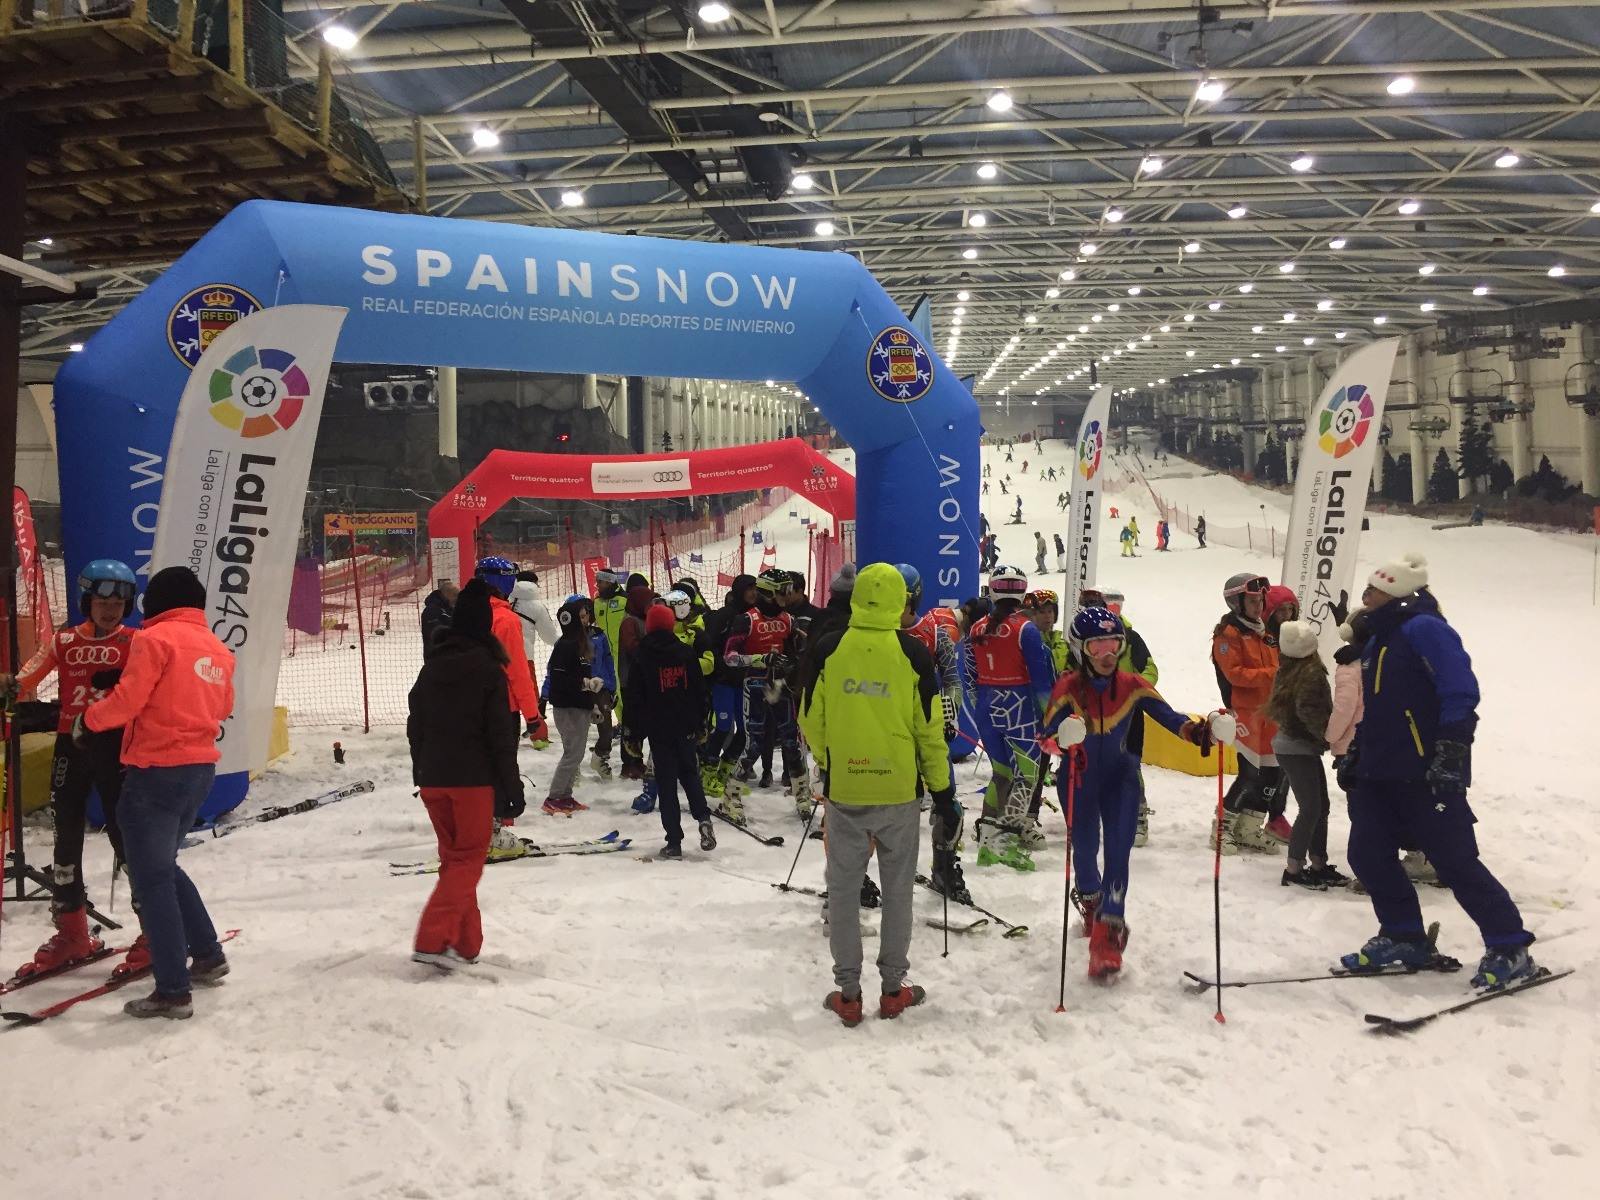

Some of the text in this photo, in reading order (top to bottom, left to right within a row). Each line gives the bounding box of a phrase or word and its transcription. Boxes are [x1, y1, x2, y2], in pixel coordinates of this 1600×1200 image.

[201, 311, 237, 321] RFEDI
[361, 297, 796, 335] REAL FEDERACIÓN ESPAÑOLA DEPORTES DE INVIERNO
[511, 474, 547, 482] Territorio
[697, 470, 735, 479] Territorio
[804, 476, 838, 486] SPAIN
[804, 481, 838, 492] SNOW
[454, 493, 487, 503] SPAIN
[453, 500, 487, 508] SNOW
[188, 449, 223, 577] LaLiga con el Depo
[344, 515, 415, 525] TOBOGGANING
[1307, 470, 1352, 637] LaLiga4Sp
[986, 653, 994, 671] 1
[847, 757, 870, 766] Audi
[847, 766, 892, 776] Superwagen
